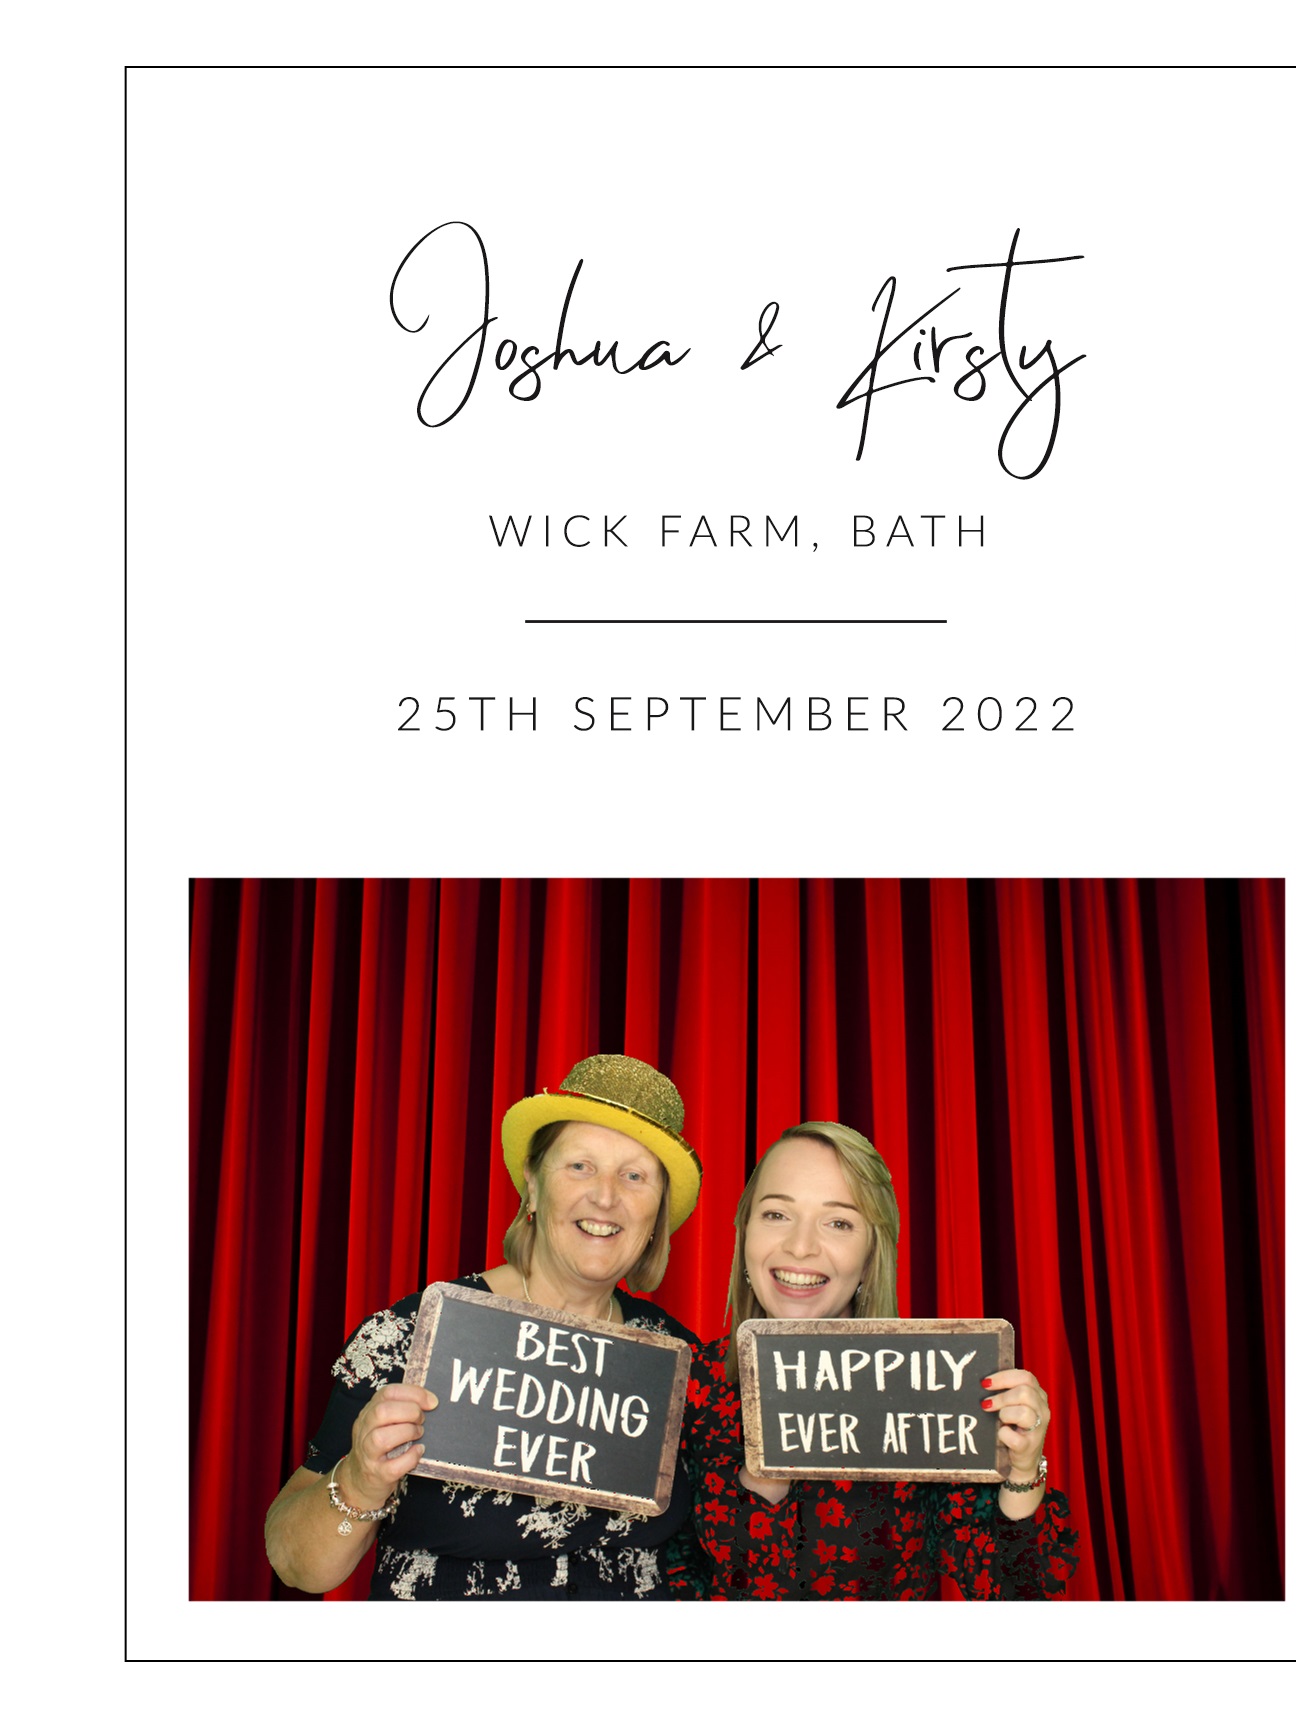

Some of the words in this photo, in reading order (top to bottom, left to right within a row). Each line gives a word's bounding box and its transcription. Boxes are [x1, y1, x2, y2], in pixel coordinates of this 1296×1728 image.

[514, 1320, 615, 1378] BEST
[772, 1348, 977, 1393] HAPPILY
[449, 1357, 650, 1438] WEDDING
[492, 1424, 597, 1485] EVER
[777, 1411, 861, 1455] EVER
[882, 1411, 979, 1456] AFTER
